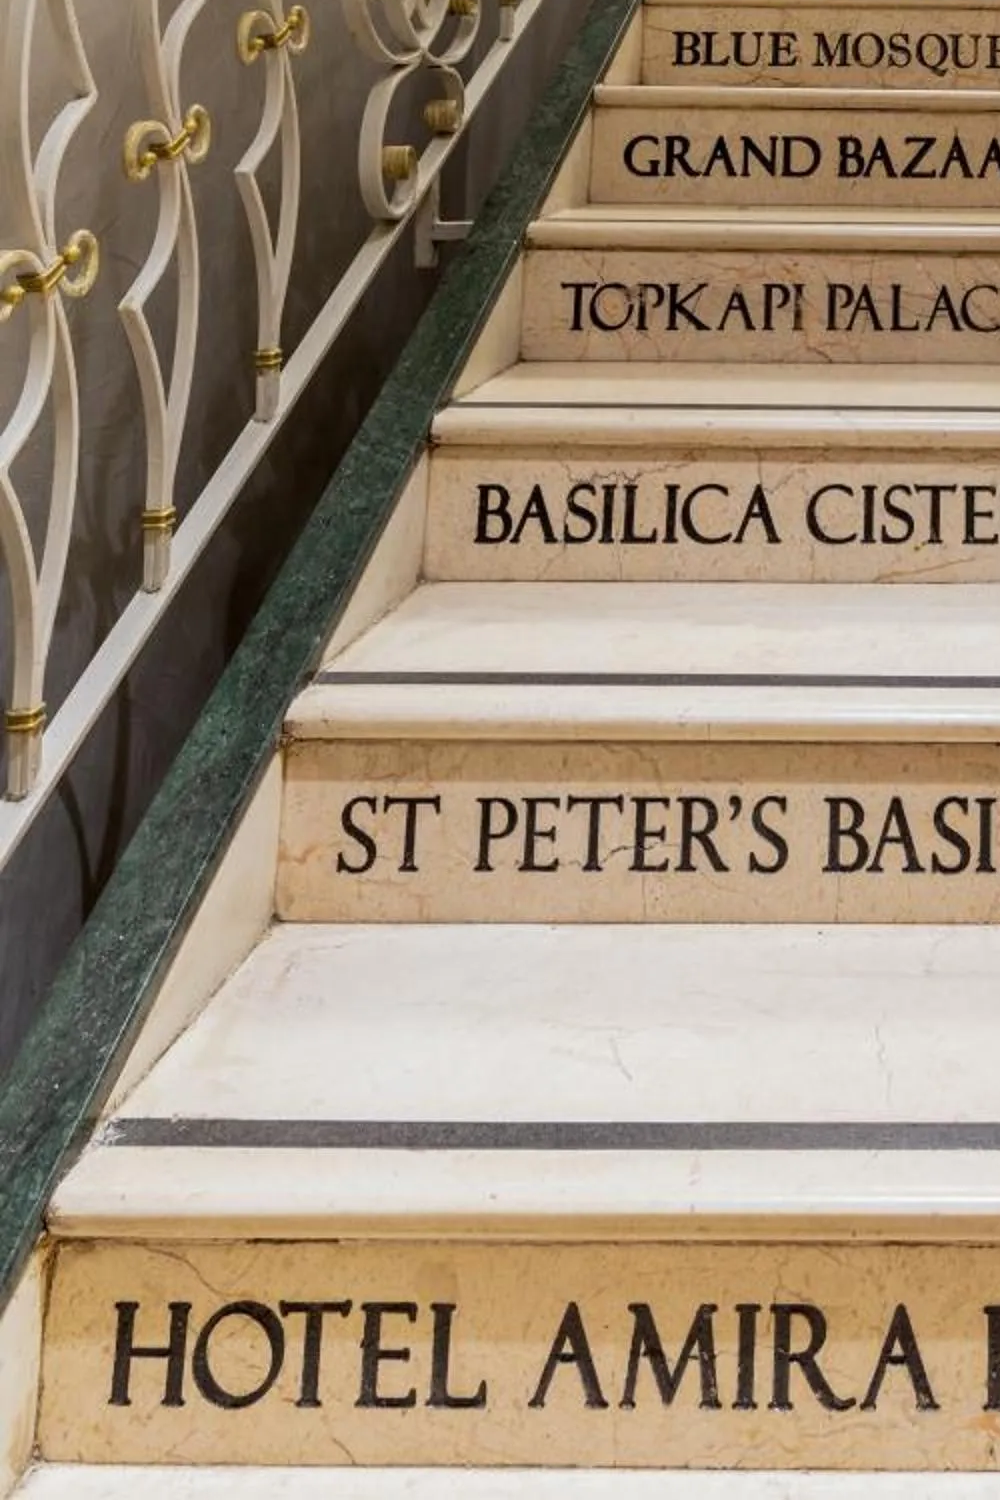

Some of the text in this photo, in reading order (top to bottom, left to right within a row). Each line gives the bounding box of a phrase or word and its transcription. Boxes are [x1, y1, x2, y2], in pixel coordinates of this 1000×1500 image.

[672, 31, 798, 67] BLUE
[623, 134, 822, 179] GRAND
[560, 281, 805, 332] TOPKAPI
[473, 483, 783, 545] BASILICA
[336, 795, 441, 874] ST
[473, 794, 790, 874] PETER'S
[107, 1300, 487, 1409] HOTEL
[527, 1301, 940, 1412] AMIRA
